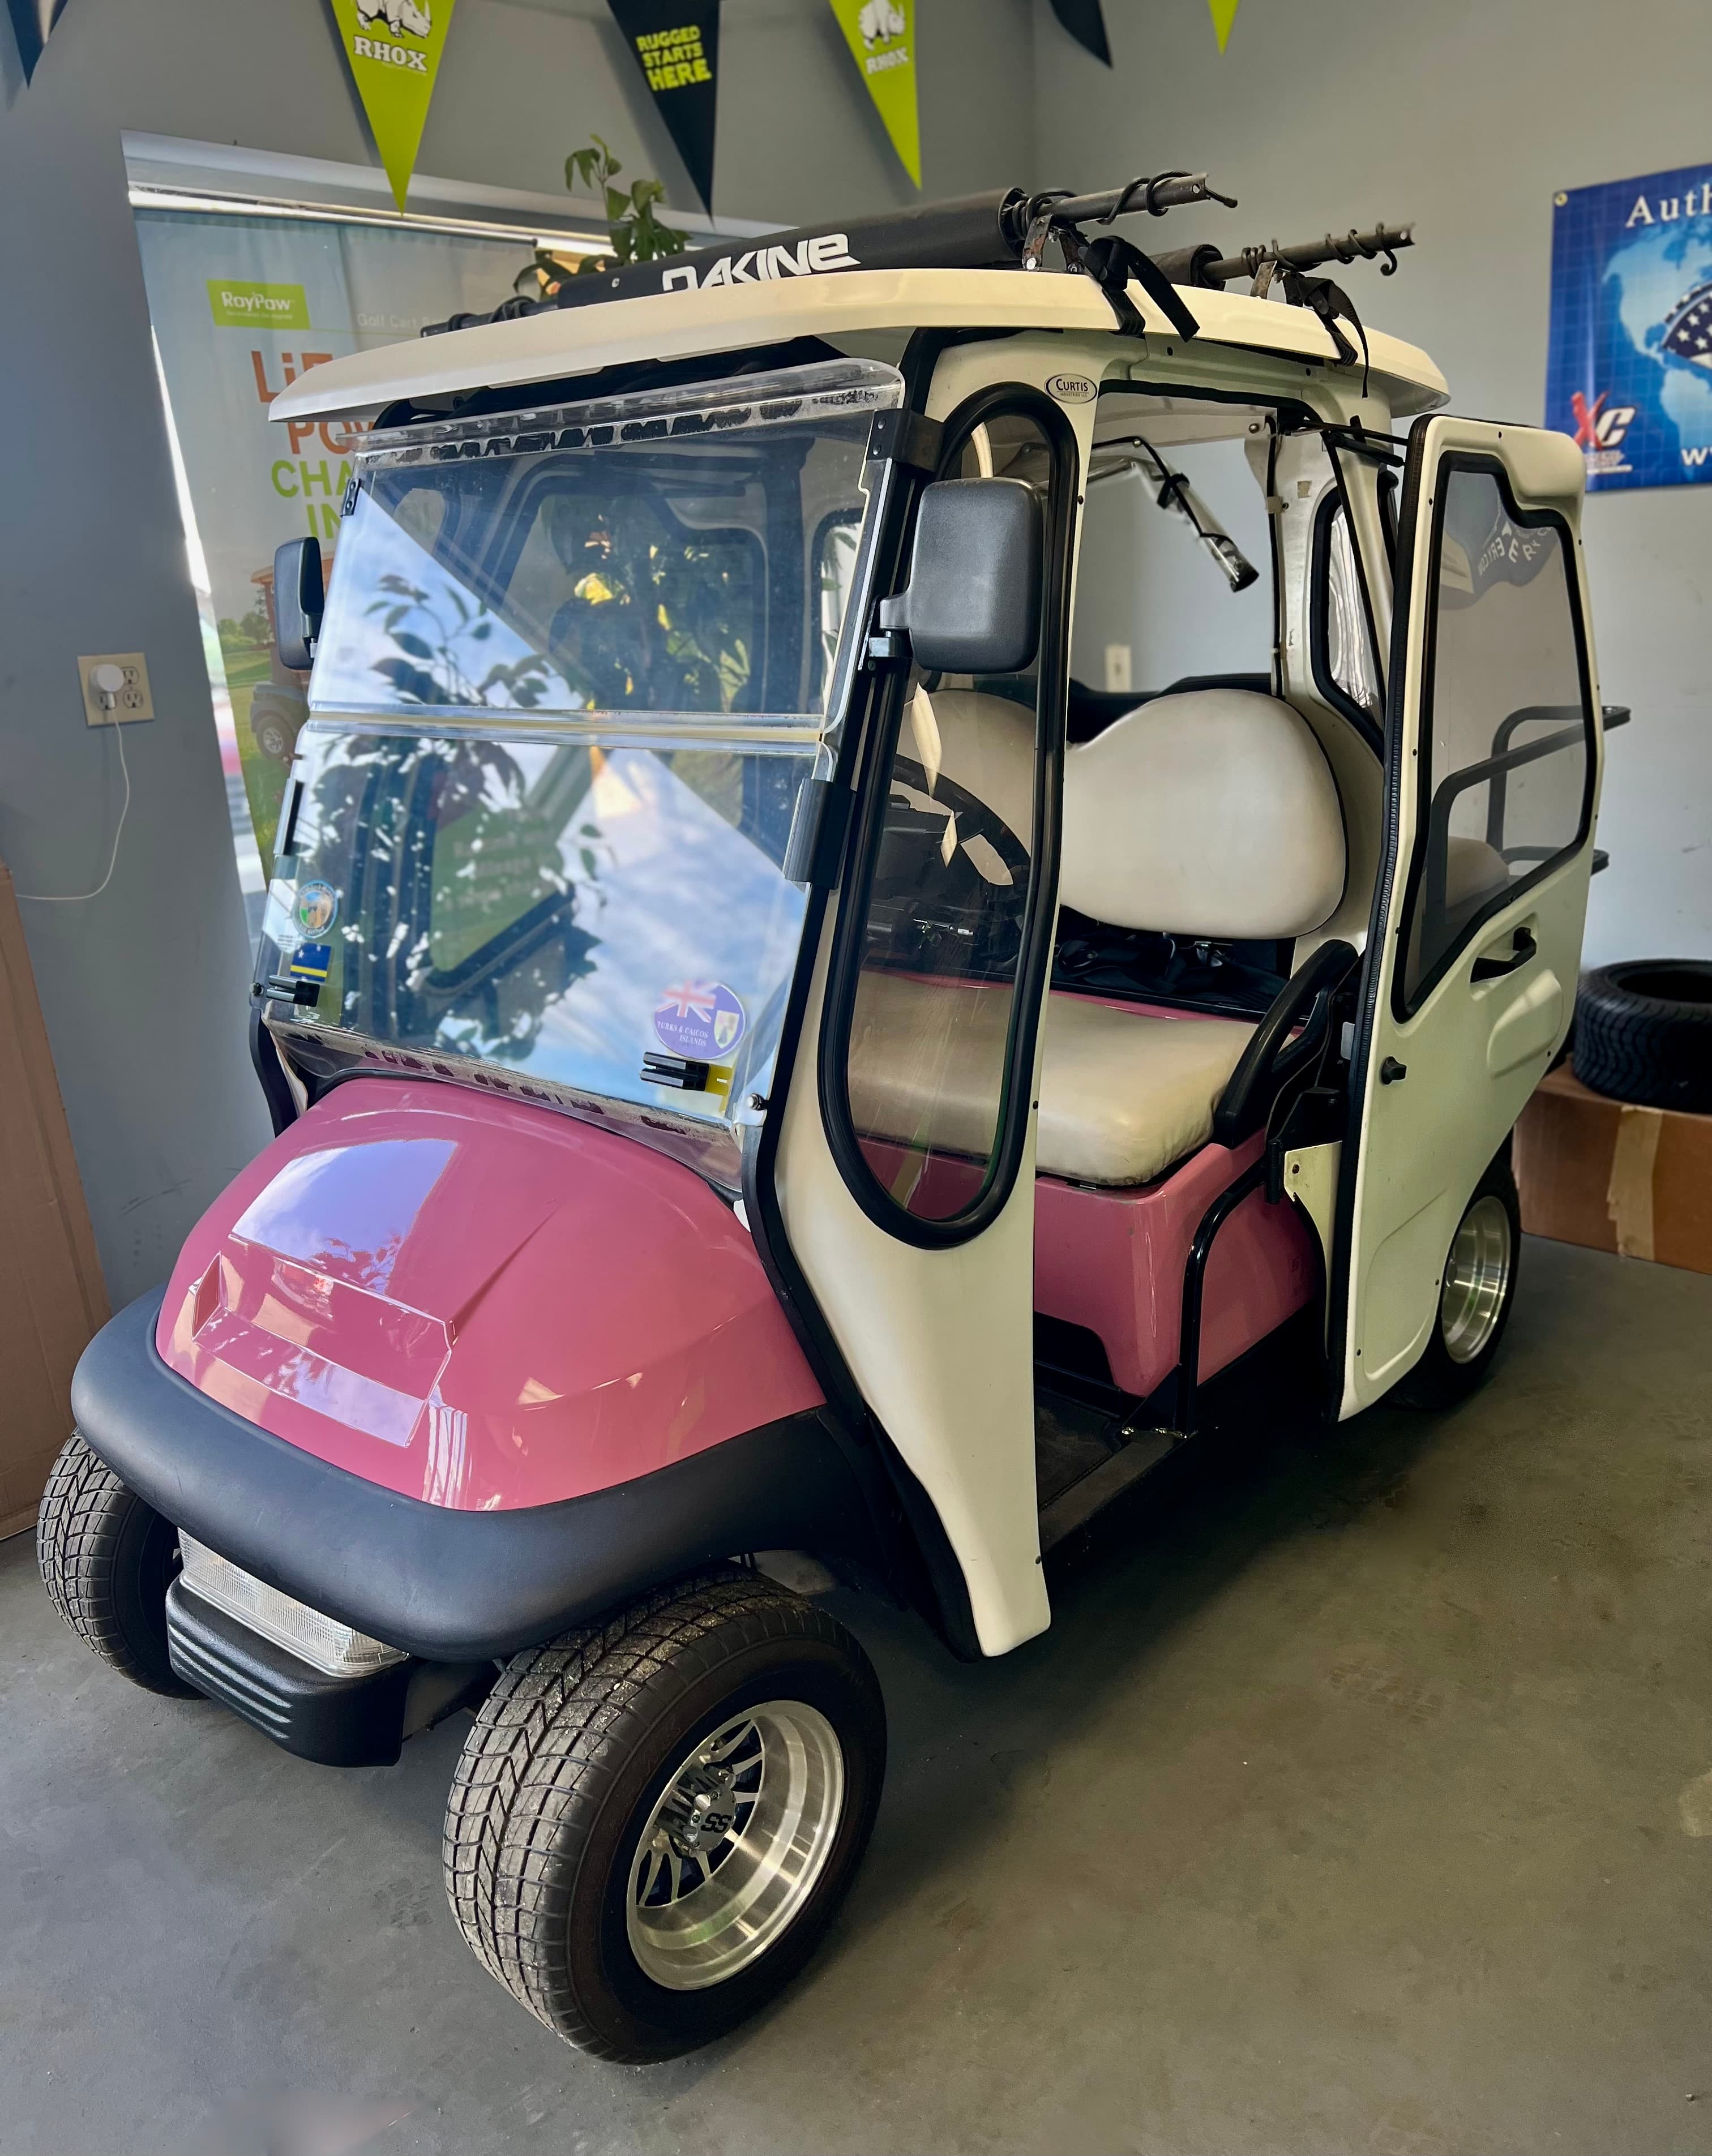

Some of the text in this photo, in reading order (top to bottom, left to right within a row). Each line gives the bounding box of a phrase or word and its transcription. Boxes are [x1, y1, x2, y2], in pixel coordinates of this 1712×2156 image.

[636, 25, 700, 52] RUGGED
[354, 35, 427, 71] RHOX
[642, 42, 703, 68] STARTS
[866, 46, 909, 75] RHOX
[647, 58, 712, 91] HERE
[357, 313, 385, 327] Golf
[1056, 379, 1088, 392] CURTIS
[657, 1021, 678, 1031] TURKS
[684, 1027, 709, 1038] CAICOS
[679, 1035, 707, 1047] ISLANDS
